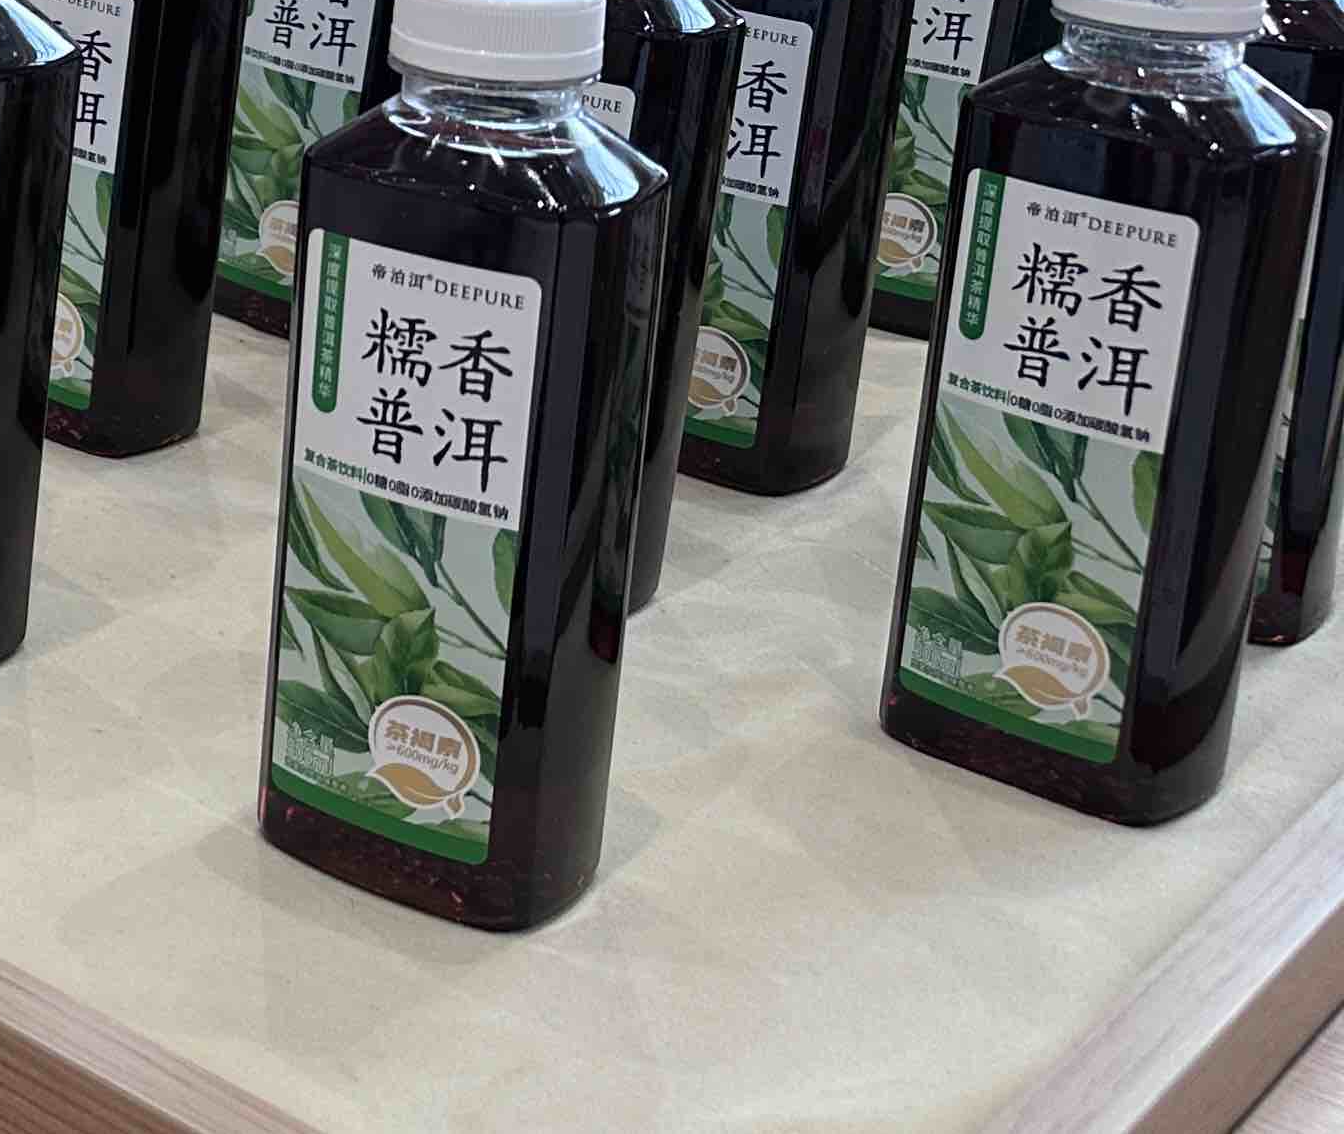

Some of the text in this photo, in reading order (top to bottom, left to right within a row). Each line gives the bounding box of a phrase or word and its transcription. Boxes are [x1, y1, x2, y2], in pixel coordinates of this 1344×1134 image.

[77, 29, 113, 82] 香
[921, 6, 975, 61] 洱
[581, 93, 623, 115] PURE
[736, 59, 789, 115] 香
[727, 118, 783, 180] 洱
[1087, 216, 1178, 249] DEEPURE
[433, 277, 526, 312] DEEPURE
[1010, 241, 1164, 333] 糯香
[360, 306, 513, 404] 糯香
[1003, 316, 1153, 417] 普洱
[355, 387, 510, 494] 普洱
